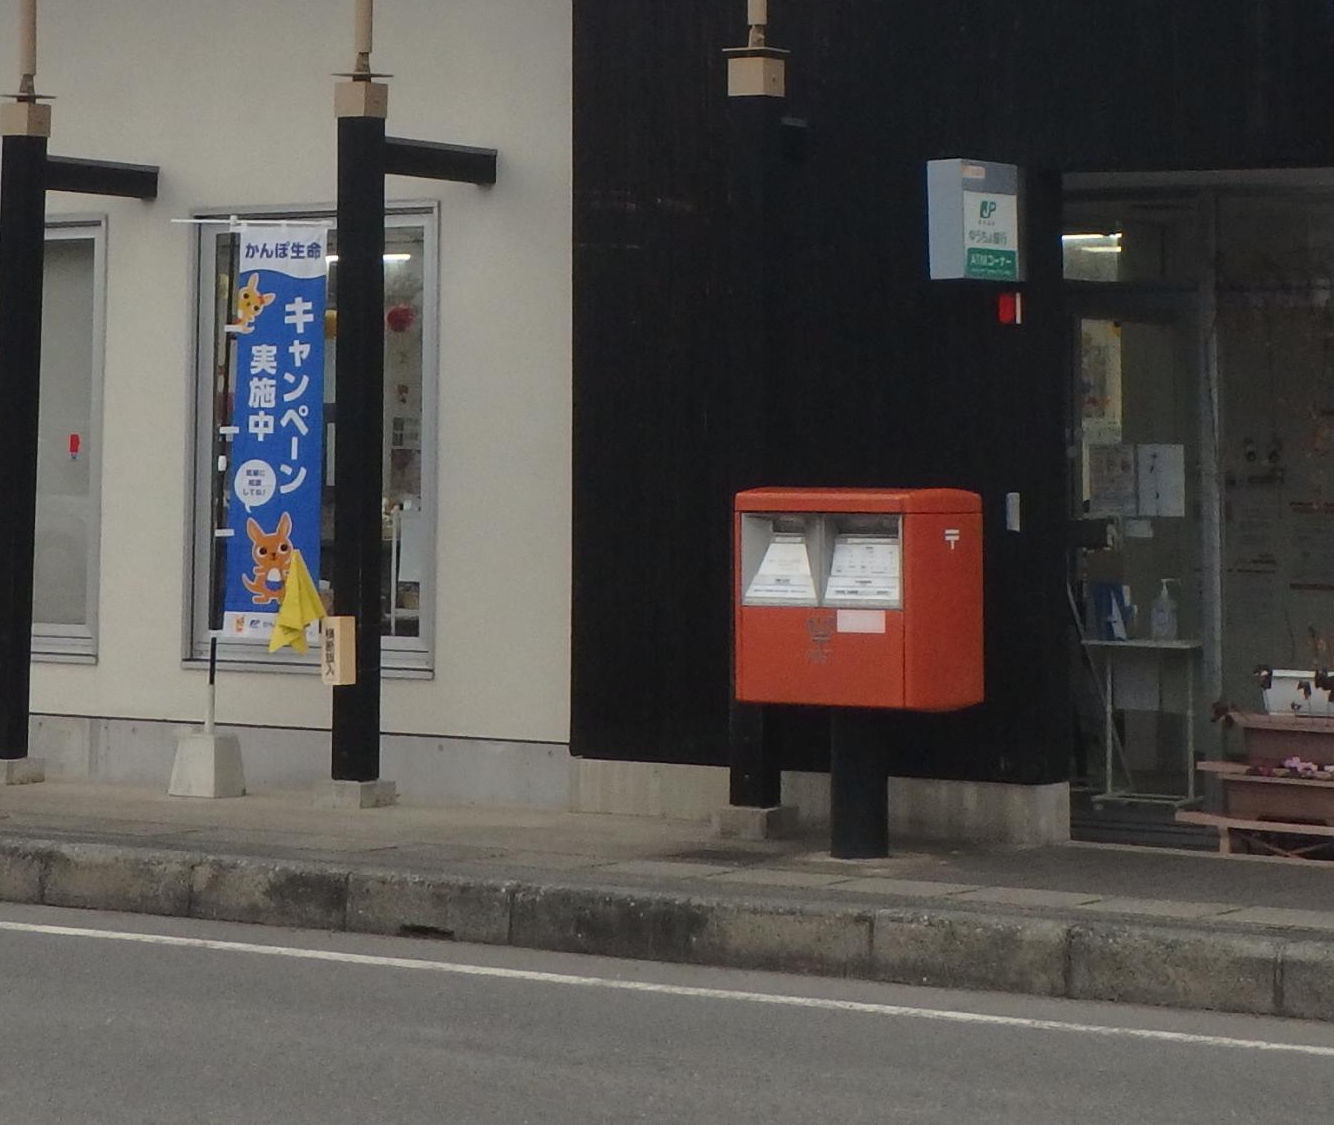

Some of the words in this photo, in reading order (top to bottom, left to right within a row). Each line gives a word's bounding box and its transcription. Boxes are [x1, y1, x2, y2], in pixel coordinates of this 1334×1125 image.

[244, 241, 322, 261] かんぽ生命
[970, 251, 1012, 267] ATMコーナー
[247, 343, 278, 442] 実施中
[278, 296, 315, 495] キャンペーン
